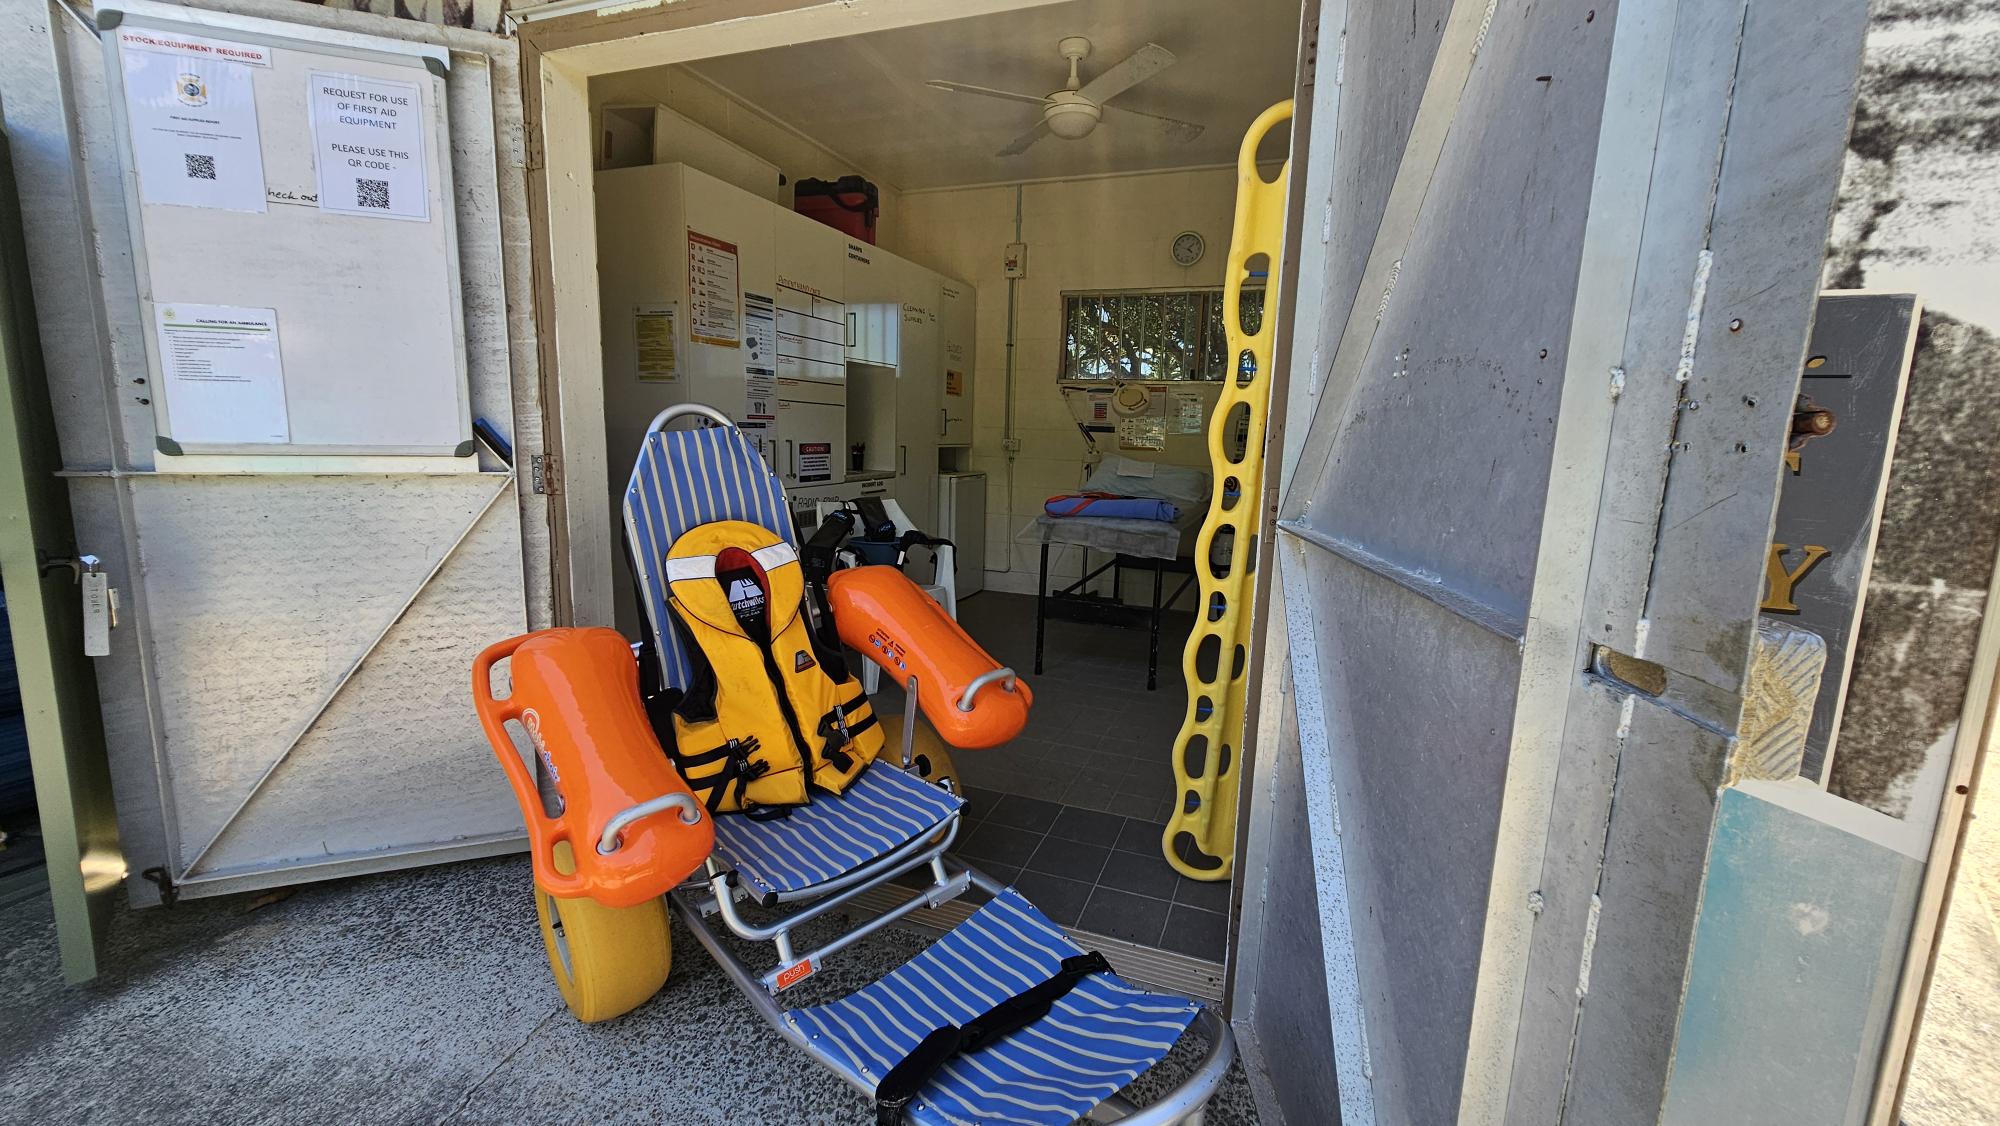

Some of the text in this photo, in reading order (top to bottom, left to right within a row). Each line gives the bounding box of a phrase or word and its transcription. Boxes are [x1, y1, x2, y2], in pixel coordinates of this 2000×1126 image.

[123, 35, 262, 60] STOCK EQUIPMENT REQUIRED
[323, 87, 408, 106] REQUEST FOR USE
[337, 102, 397, 117] OF FIRST AID
[339, 115, 397, 130] EQUIPMENT
[331, 143, 409, 160] PLEASE USE THIS
[347, 158, 362, 168] QR
[364, 160, 390, 171] CODE
[267, 187, 318, 202] heck out
[1760, 543, 1831, 614] Y
[783, 964, 805, 983] push
